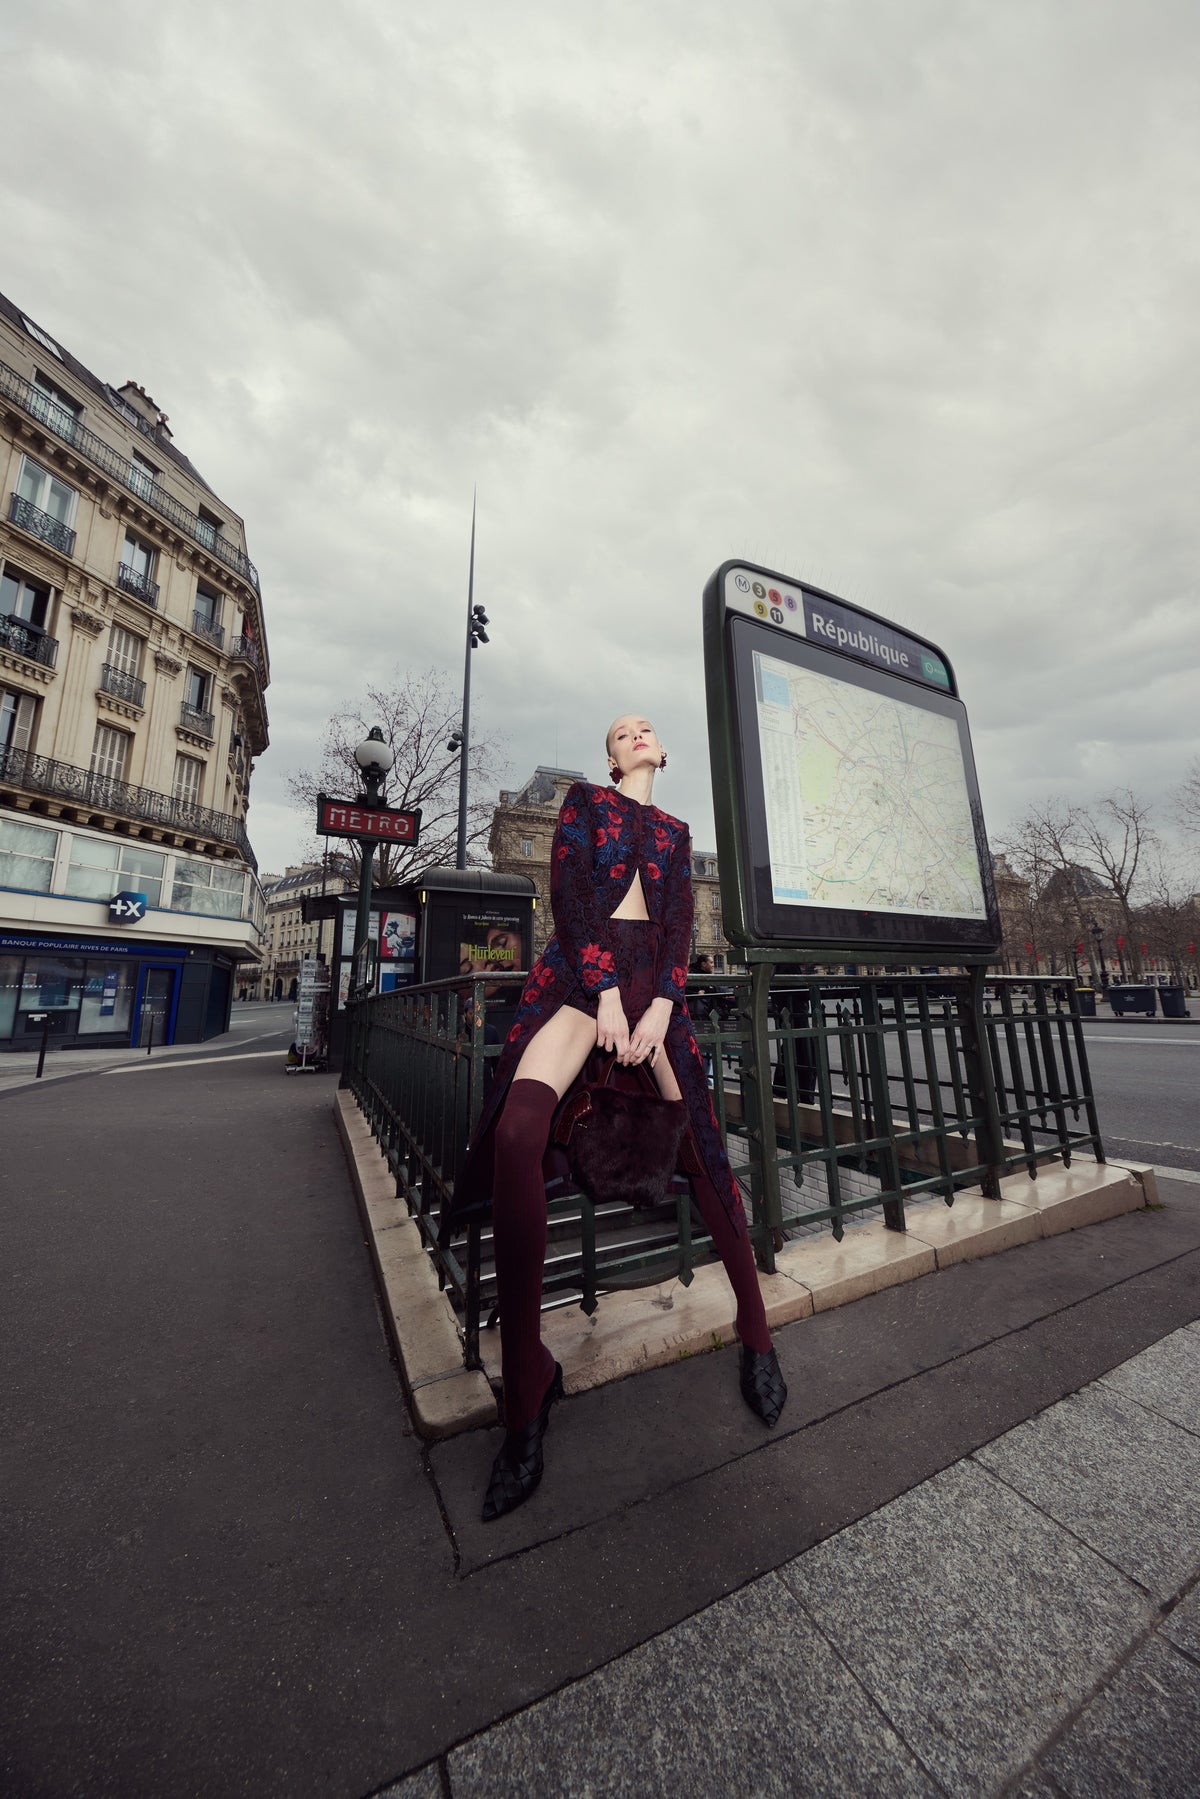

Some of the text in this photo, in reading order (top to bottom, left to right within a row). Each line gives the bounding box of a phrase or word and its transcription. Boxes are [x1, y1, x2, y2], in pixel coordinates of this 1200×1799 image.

[755, 585, 763, 596] 3
[772, 591, 779, 602] 5
[788, 598, 794, 609] 8
[757, 604, 781, 622] 9 11
[812, 613, 909, 668] République
[329, 807, 409, 835] METRO
[1, 939, 36, 947] BANQUE
[38, 941, 79, 950] POPULAIRE
[468, 944, 515, 962] Hurlevent
